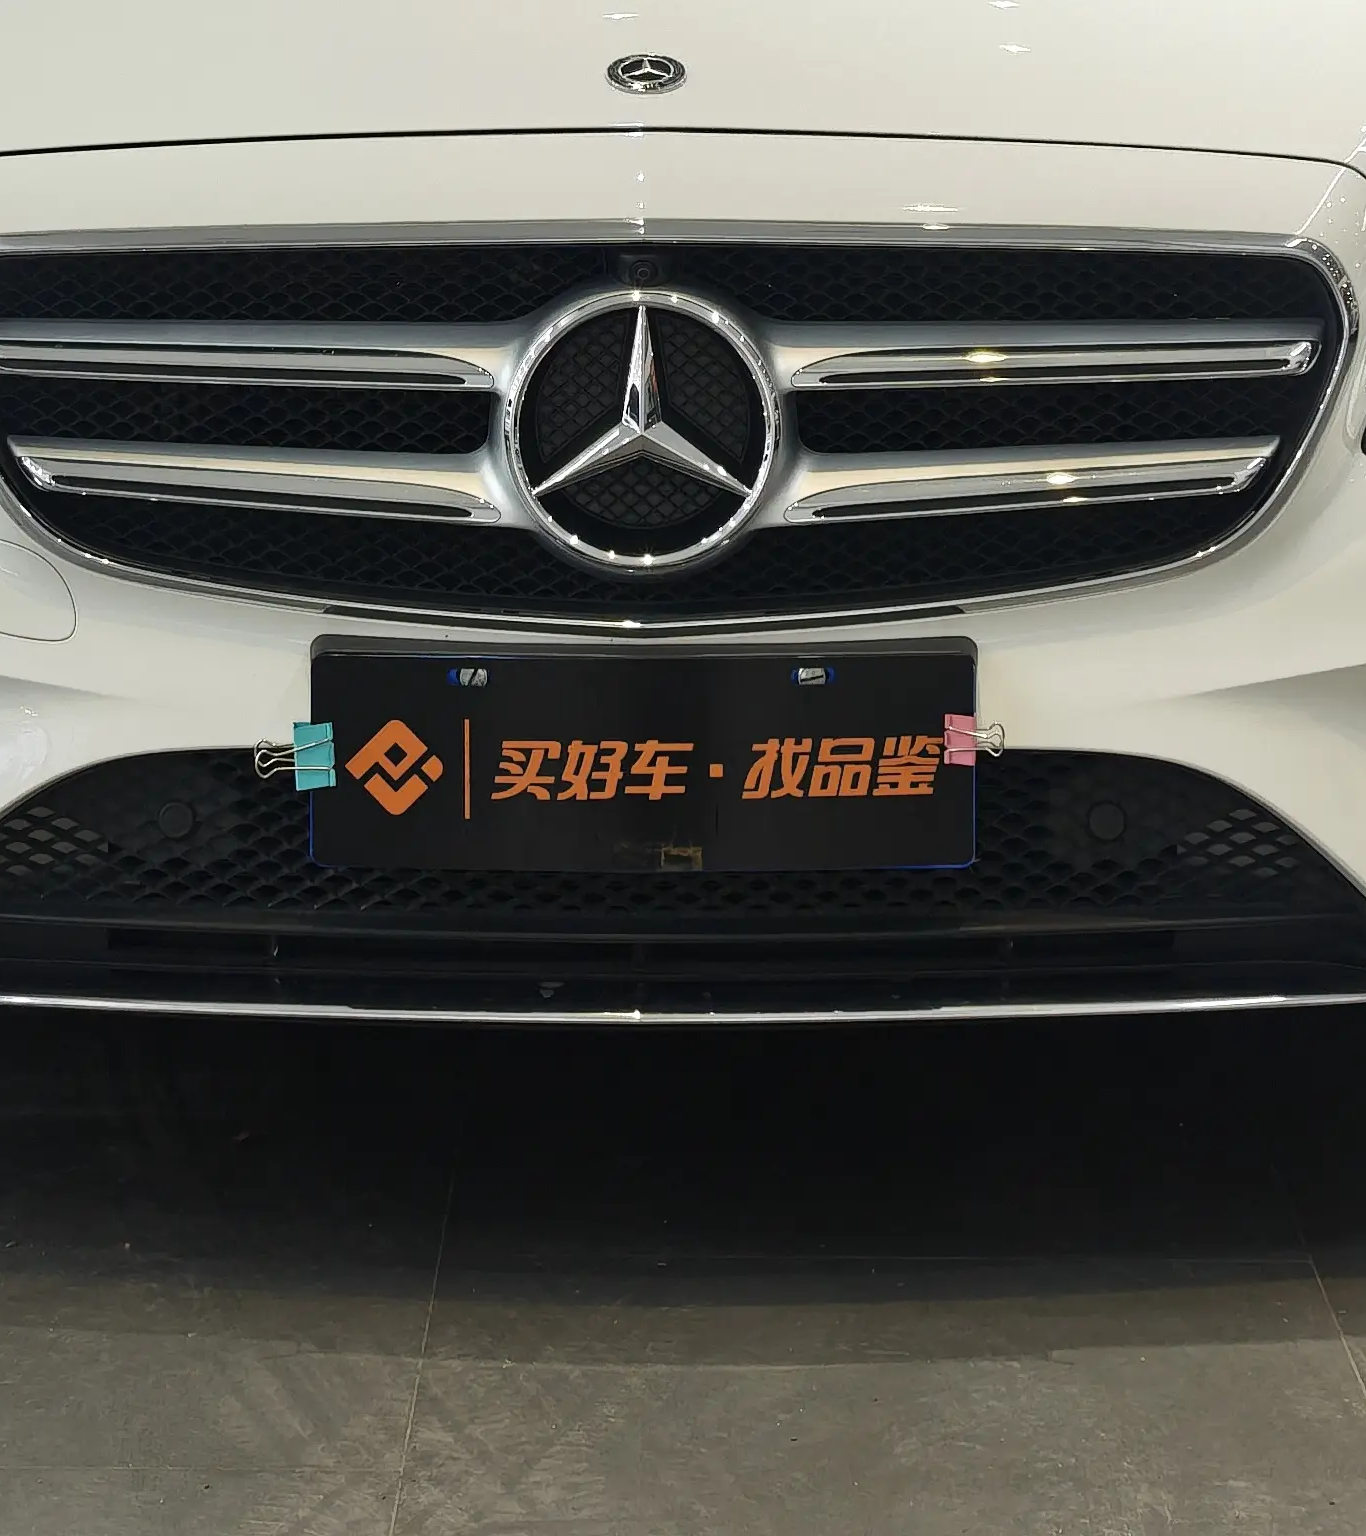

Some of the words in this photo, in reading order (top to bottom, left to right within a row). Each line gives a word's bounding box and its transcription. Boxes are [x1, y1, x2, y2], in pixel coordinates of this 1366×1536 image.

[491, 735, 944, 801] 买好车·找品鉴
